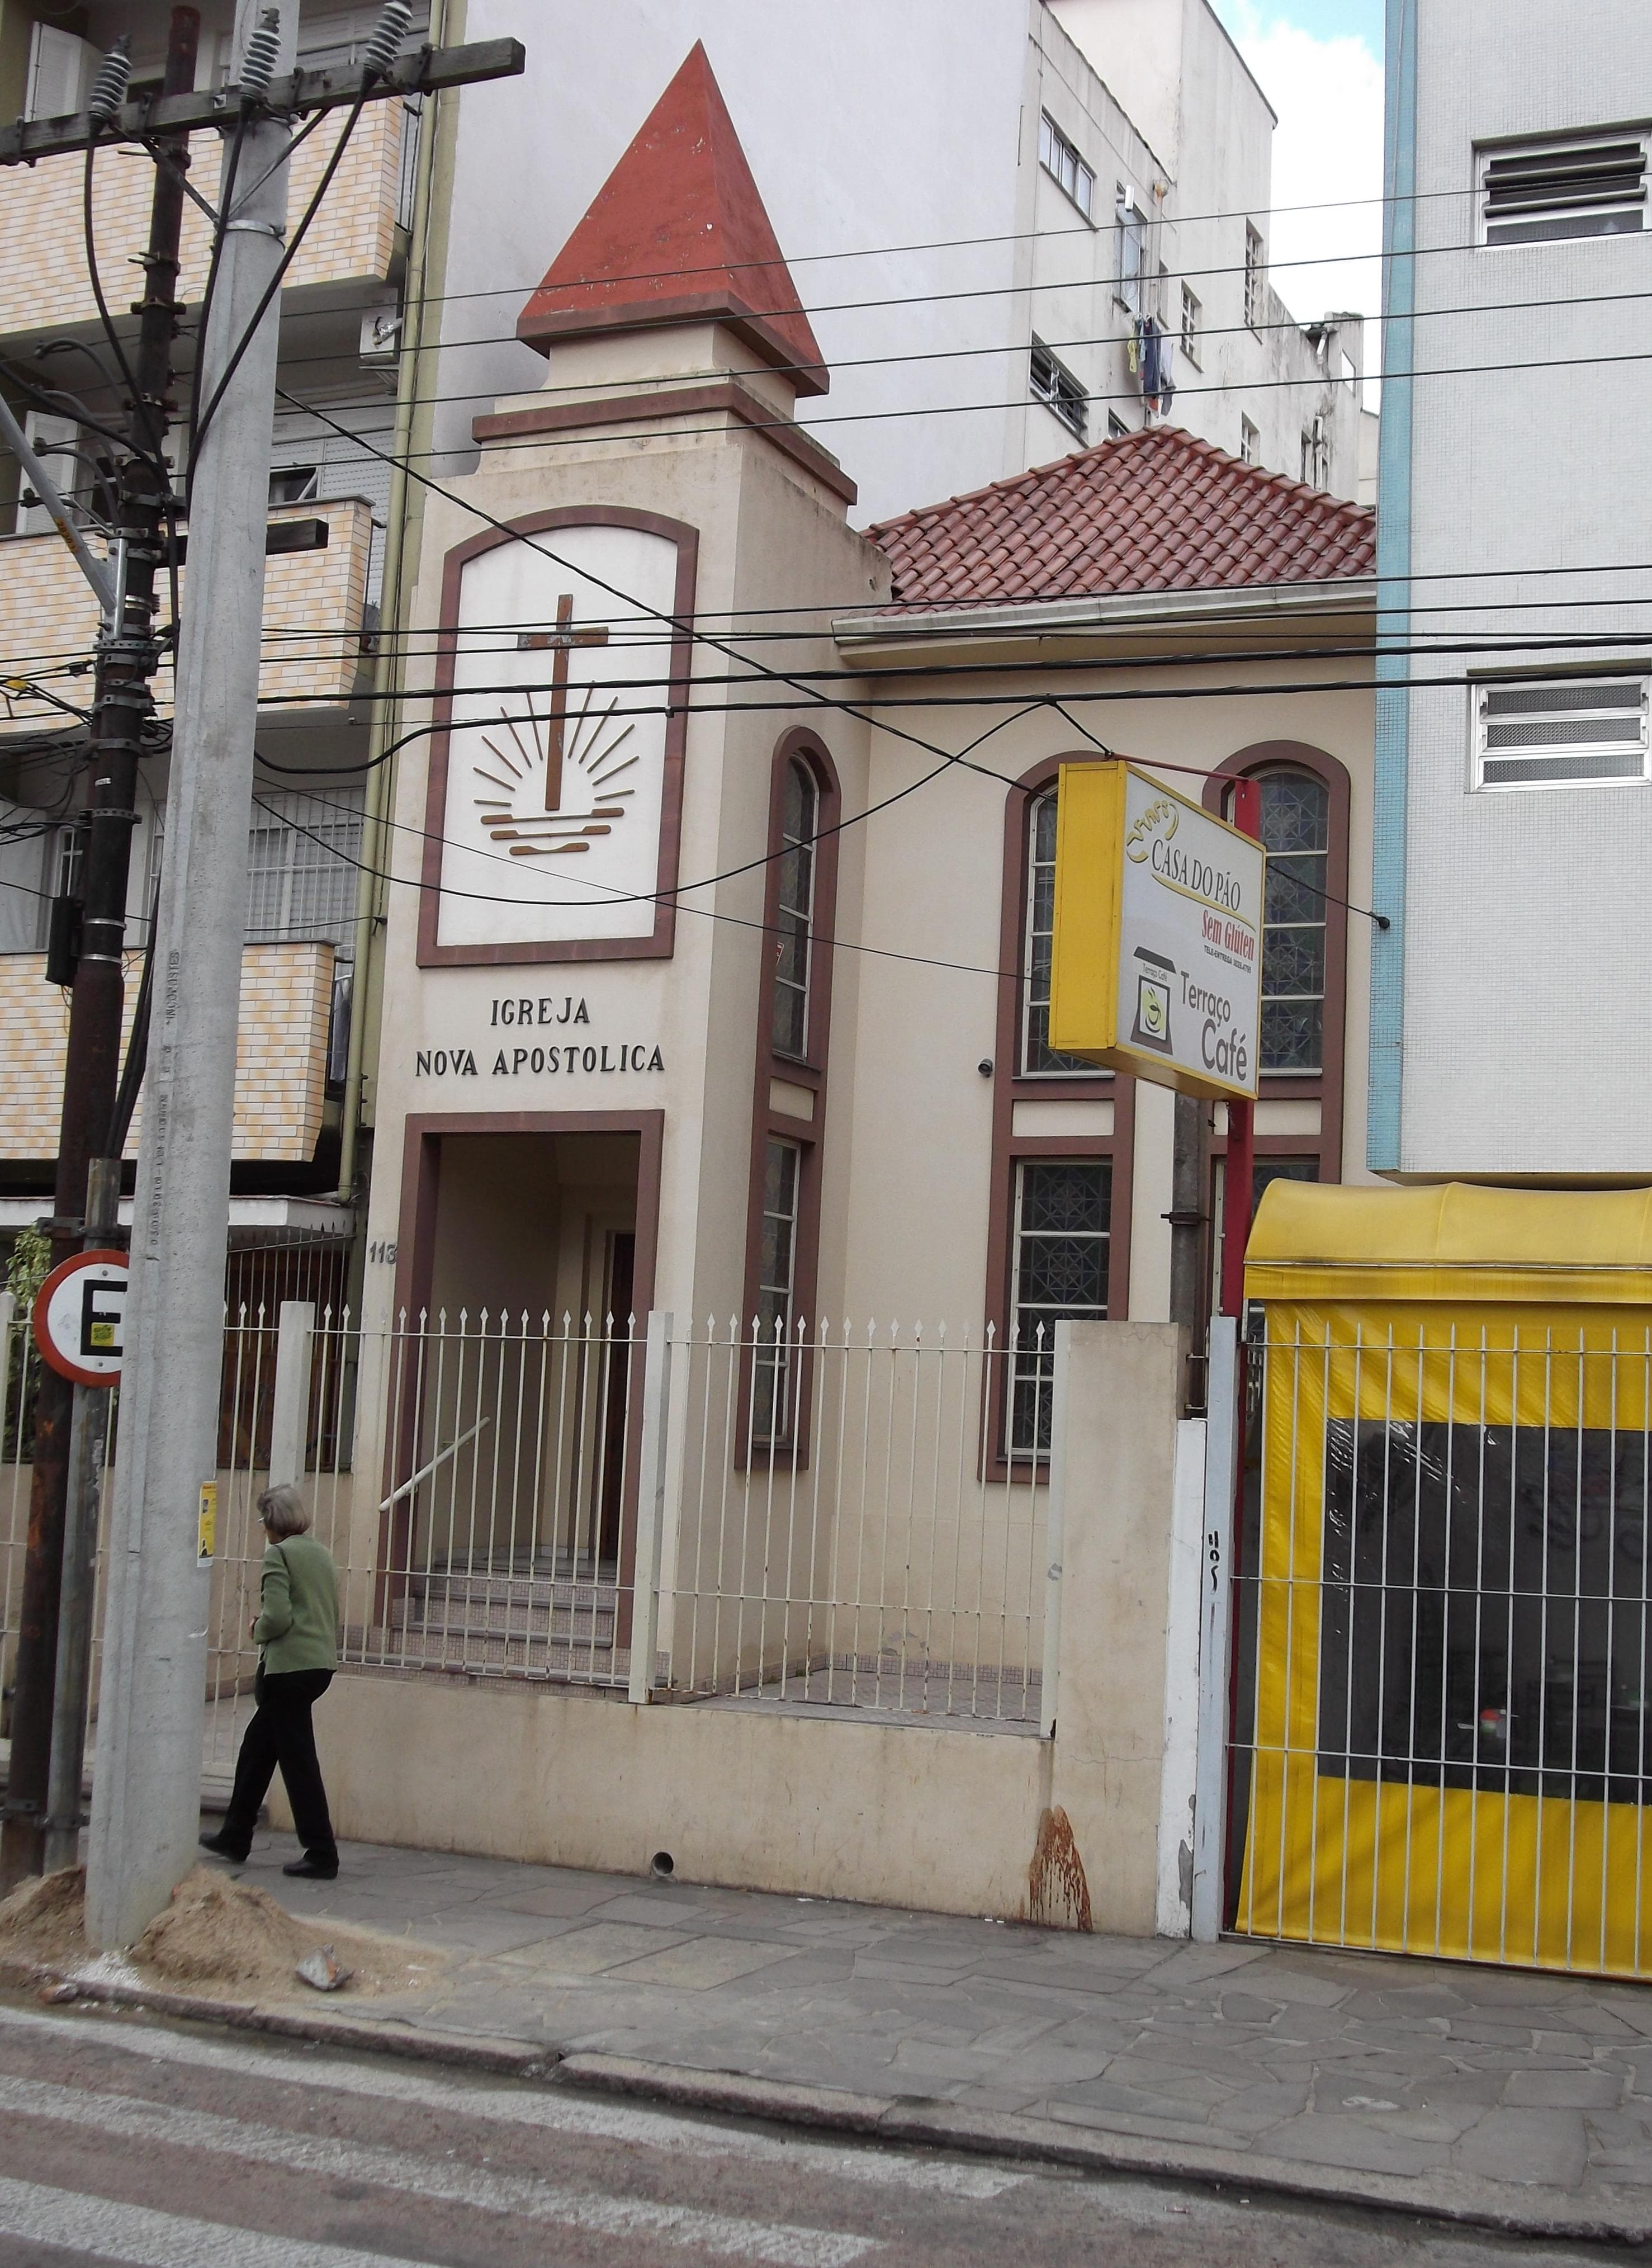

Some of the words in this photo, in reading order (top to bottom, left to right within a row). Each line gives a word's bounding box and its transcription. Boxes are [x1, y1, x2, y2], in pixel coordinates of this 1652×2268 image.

[1152, 839, 1187, 885] CASA
[1191, 859, 1213, 896] DO
[1214, 871, 1241, 911] PÃO
[1202, 909, 1222, 946] Sem
[1224, 921, 1255, 961] Glúten
[490, 996, 590, 1026] IGREJA
[1180, 970, 1231, 1028] Terraço
[415, 1048, 479, 1076] NOVA
[491, 1044, 665, 1075] APOSTOLICA
[1202, 1018, 1248, 1081] Café
[370, 1241, 399, 1265] 113
[81, 1279, 127, 1357] E
